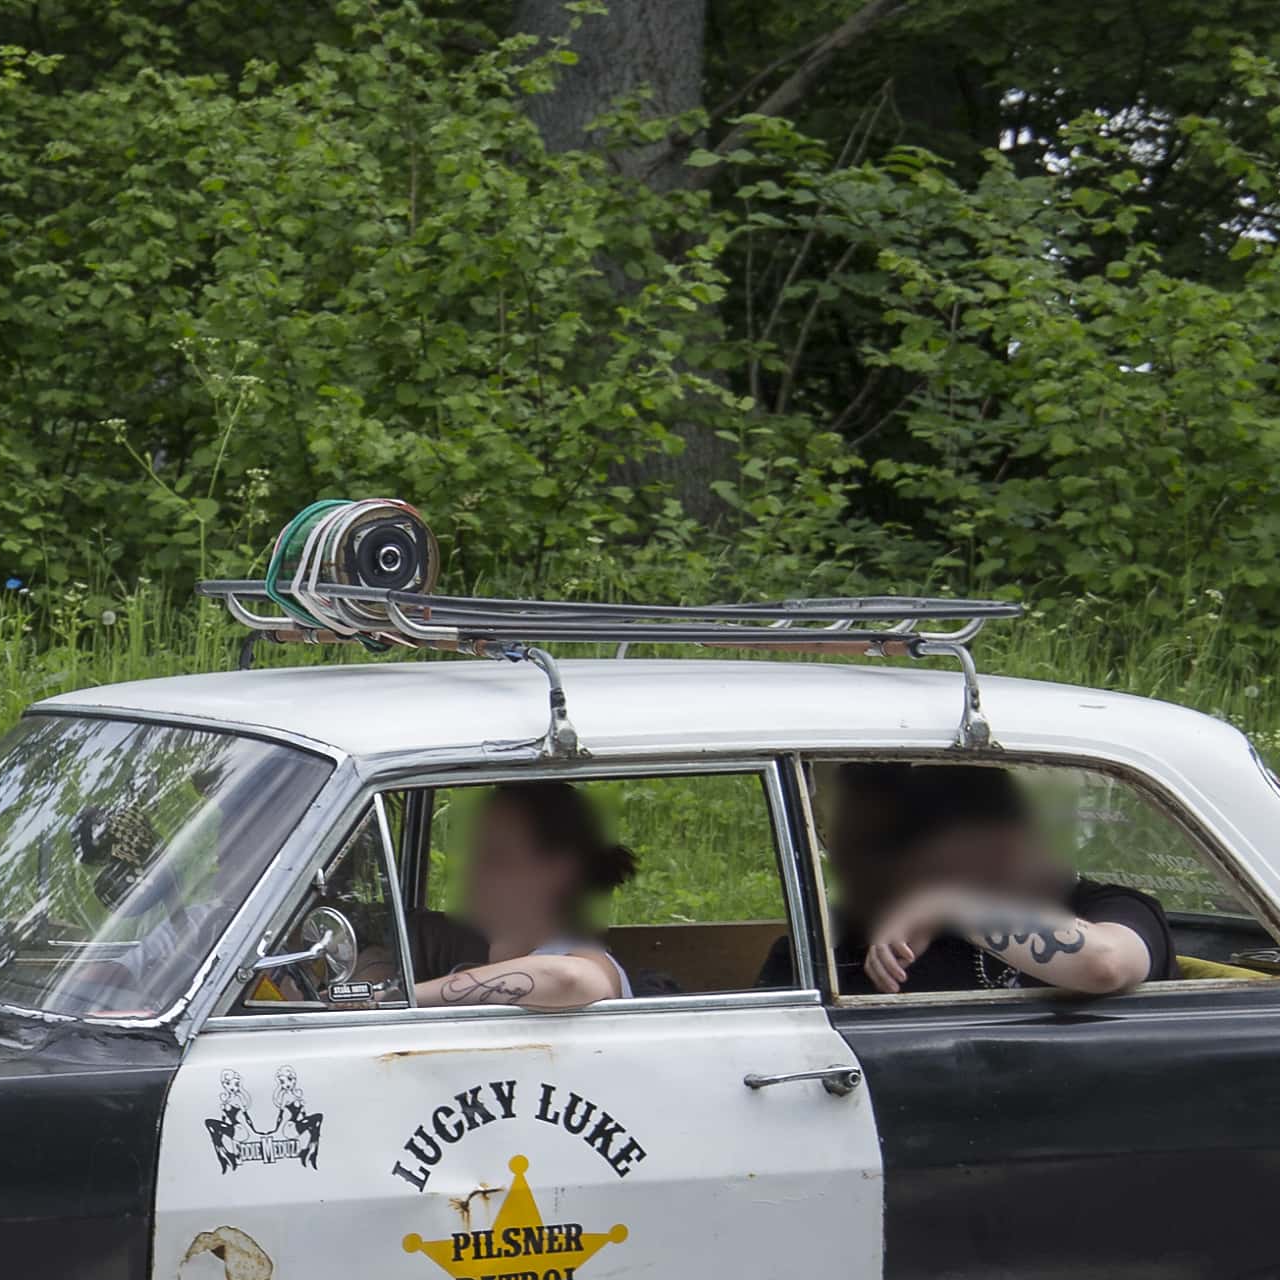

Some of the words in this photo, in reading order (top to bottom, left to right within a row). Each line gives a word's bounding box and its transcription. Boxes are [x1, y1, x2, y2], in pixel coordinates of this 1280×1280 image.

[391, 1080, 517, 1193] LUCKY
[535, 1083, 648, 1178] LUKE
[451, 1223, 585, 1262] PILSNER
